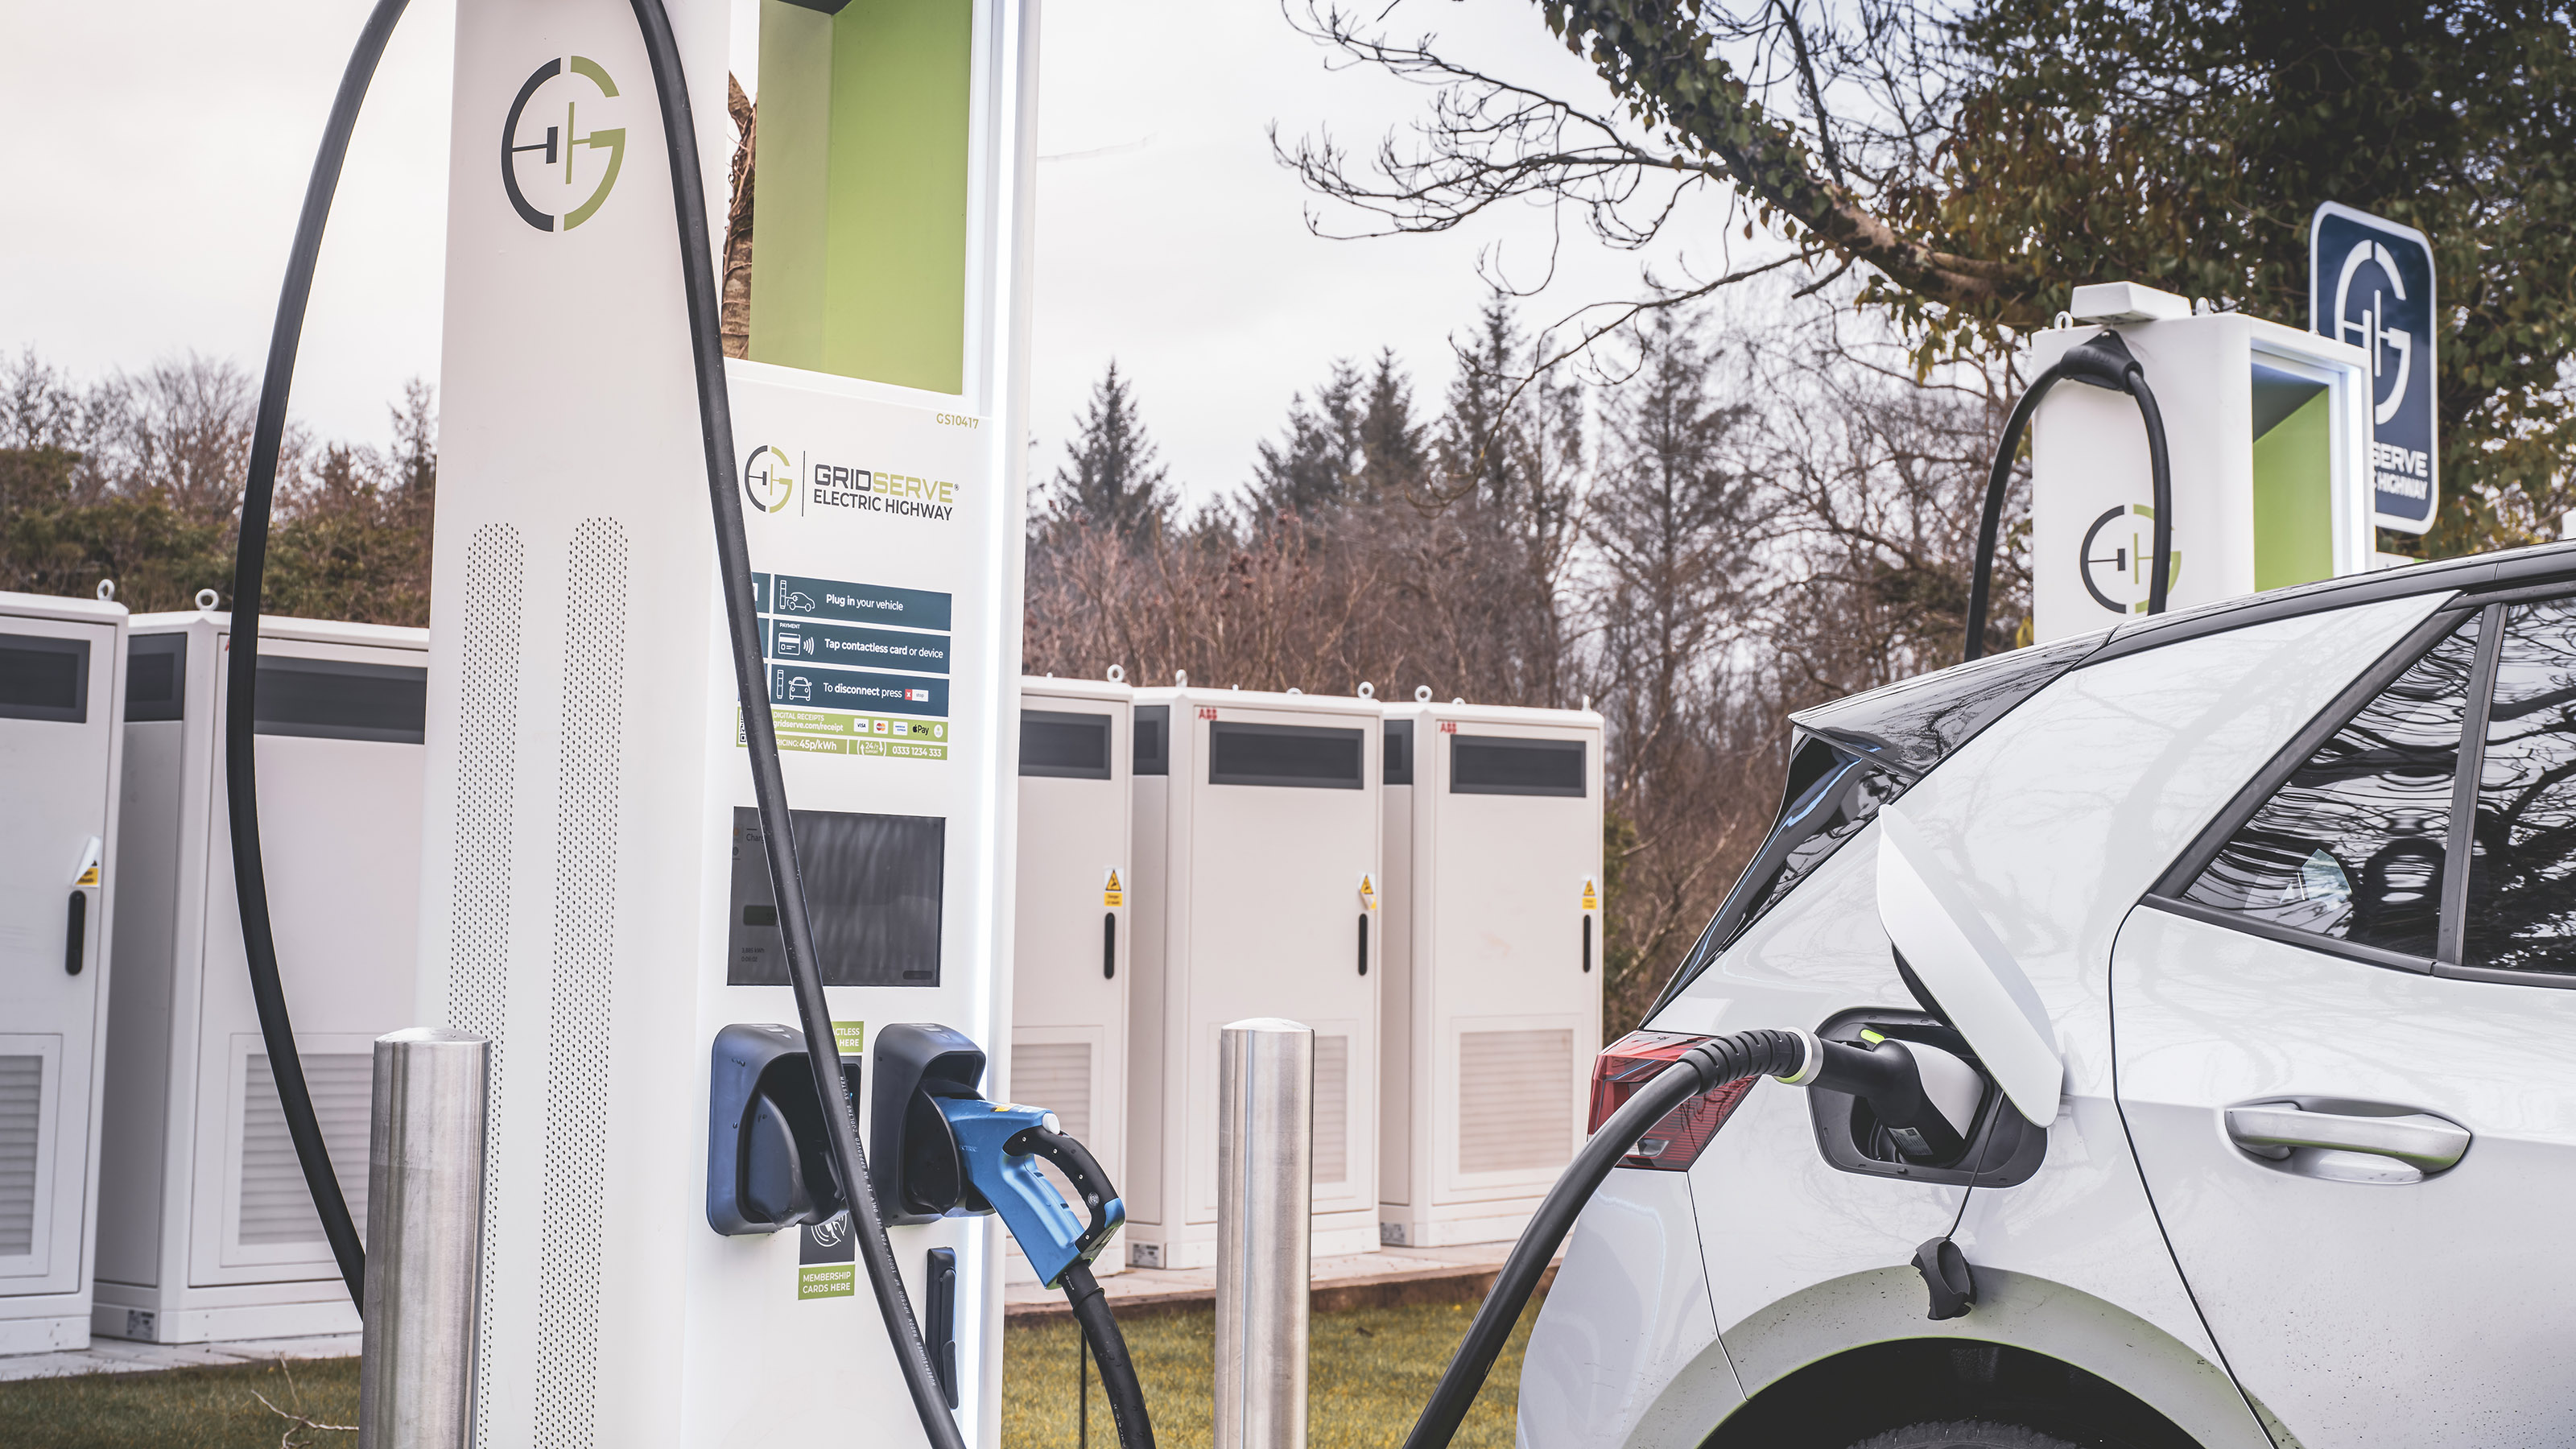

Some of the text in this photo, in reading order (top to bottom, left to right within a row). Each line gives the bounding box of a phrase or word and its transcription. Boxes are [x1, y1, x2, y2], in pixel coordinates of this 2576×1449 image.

[936, 412, 979, 429] GS10417
[814, 489, 952, 521] ELECTRIC HIGHWAY
[826, 593, 903, 611] Plug in your vehicle
[824, 638, 943, 658] Tap contactless card or device
[824, 682, 902, 698] To disconnect press
[773, 712, 824, 721] DIGITAL RECEIPTS
[1199, 708, 1217, 720] ABB
[773, 720, 844, 732] gridserve.com/receipt
[918, 725, 929, 736] Pay
[1440, 722, 1457, 733] ABB
[777, 739, 837, 751] RICING: 45p/kWh
[893, 745, 942, 757] 0333 1234 333
[835, 1028, 860, 1036] CTLESS
[840, 1038, 859, 1046] HERE
[840, 1076, 849, 1100] SYSTEM
[855, 1137, 868, 1169] APPROVED
[867, 1184, 873, 1192] IN
[870, 1196, 878, 1212] ONLY
[875, 1217, 883, 1229] USE
[886, 1254, 897, 1274] 1000V
[803, 1271, 852, 1282] MEMBERSHIP
[803, 1282, 851, 1294] CARDS HERE
[907, 1319, 919, 1337] RADOX
